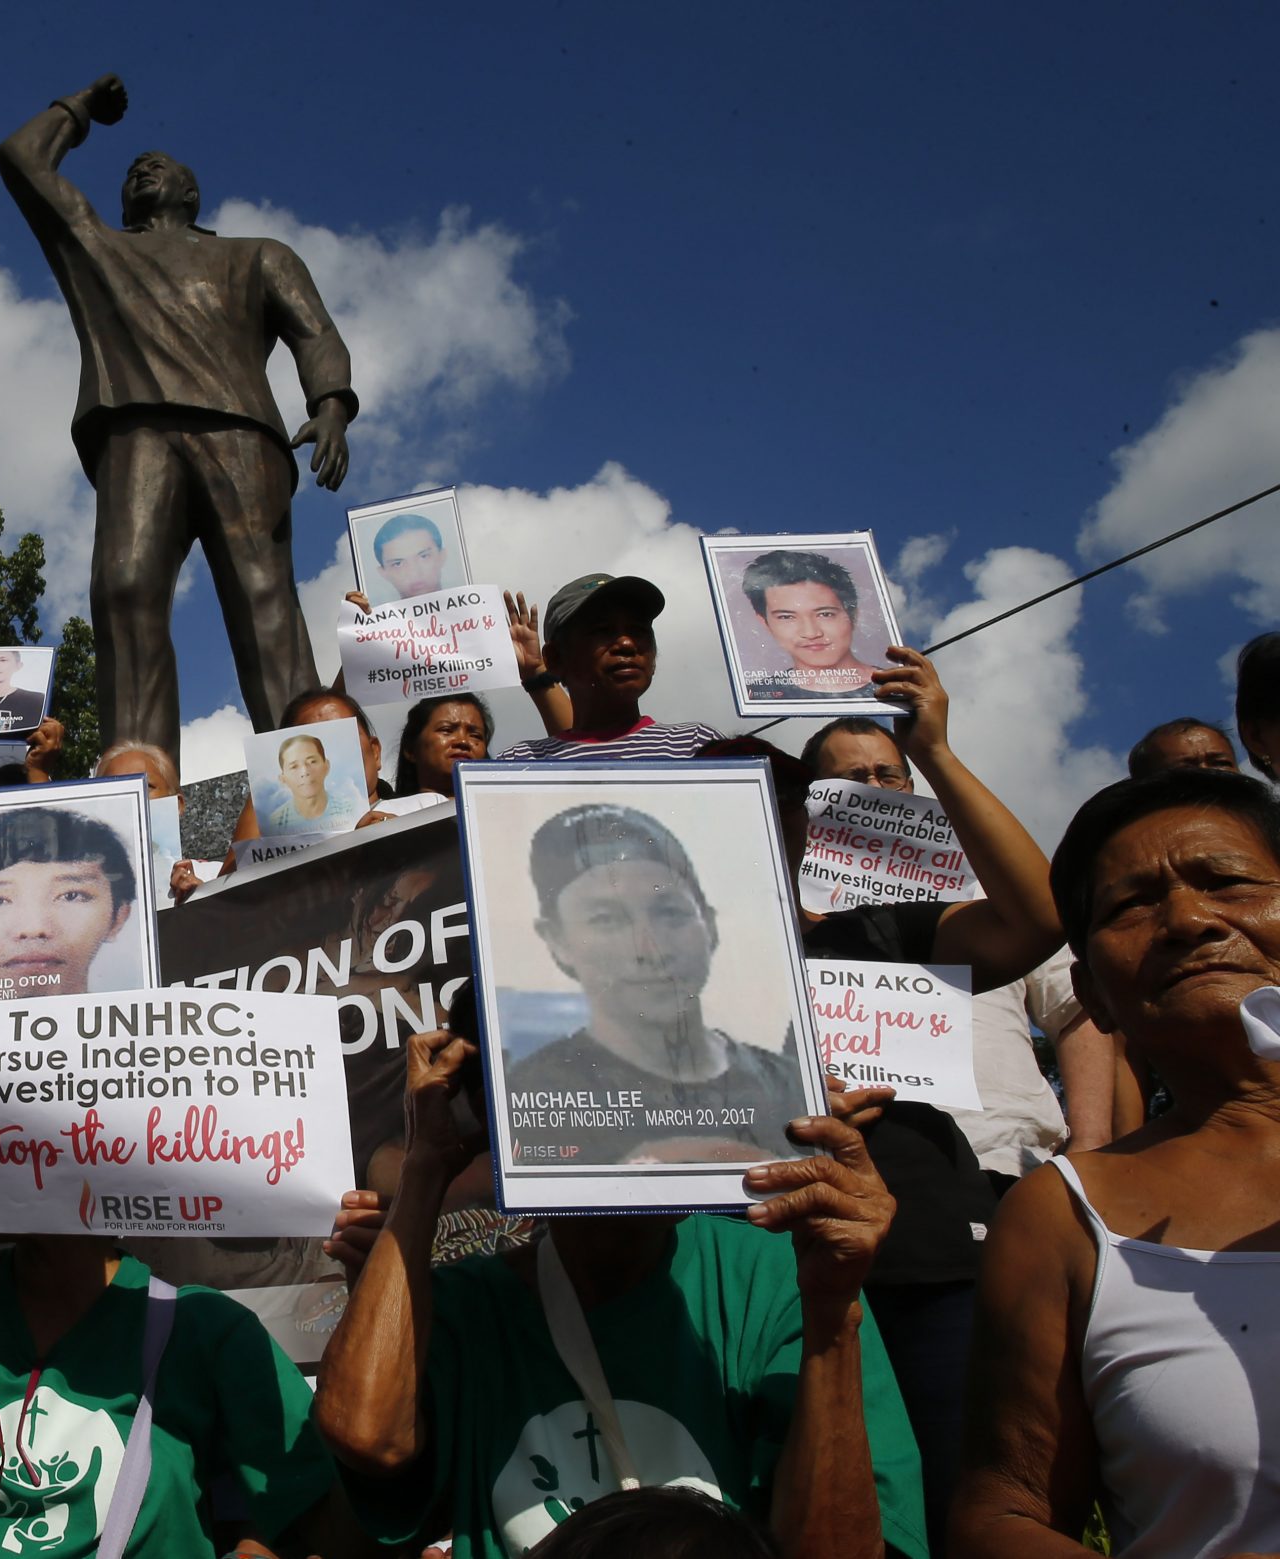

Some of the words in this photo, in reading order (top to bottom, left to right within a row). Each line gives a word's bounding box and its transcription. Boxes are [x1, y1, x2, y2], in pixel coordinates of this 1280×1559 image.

[355, 608, 407, 625] NANAY
[413, 600, 440, 617] DIN
[447, 593, 486, 610] AKO.
[408, 615, 448, 638] huli
[450, 618, 479, 637] pa
[483, 615, 496, 630] si
[368, 657, 493, 683] #StoptheKillings
[412, 677, 446, 692] RISE
[448, 674, 469, 688] UP
[743, 670, 771, 678] CARL
[774, 669, 816, 678] ANGELO
[820, 668, 858, 676] ARNAIZ
[745, 678, 763, 686] DATE
[764, 678, 774, 686] OF
[775, 678, 810, 686] INCIDENT:
[847, 793, 916, 820] Duterte
[821, 805, 953, 844] Accountable!
[809, 824, 883, 851] ustice
[890, 839, 925, 862] for
[931, 851, 964, 871] all
[801, 861, 939, 902] #InvestigatePH
[860, 856, 881, 872] of
[886, 858, 965, 891] killings!
[372, 902, 470, 974] OF
[18, 974, 60, 988] OTOM
[820, 970, 864, 988] DIN
[875, 974, 941, 996] AKO.
[9, 1010, 58, 1042] To
[77, 1002, 256, 1039] UNHRC:
[875, 1010, 924, 1030] pa
[930, 1013, 952, 1037] si
[81, 1040, 316, 1073] Independent
[816, 1027, 881, 1064] yca!
[204, 1069, 240, 1097] to
[254, 1070, 307, 1099] PH!
[511, 1092, 601, 1109] MICHAEL
[607, 1090, 643, 1108] LEE
[513, 1111, 545, 1127] DATE
[549, 1111, 566, 1127] OF
[570, 1110, 634, 1127] INCIDENT:
[645, 1110, 692, 1126] MARCH
[697, 1109, 718, 1127] 20,
[722, 1108, 755, 1125] 2017
[60, 1108, 137, 1166] the
[147, 1104, 305, 1186] killings!
[523, 1145, 557, 1158] RISE
[560, 1145, 579, 1158] UP
[100, 1195, 173, 1220] RISE
[178, 1196, 223, 1221] UP
[104, 1222, 123, 1230] FOR
[125, 1222, 143, 1230] LIFE
[144, 1223, 165, 1231] AND
[167, 1223, 186, 1231] FOR
[189, 1223, 225, 1231] RIGHTS!
